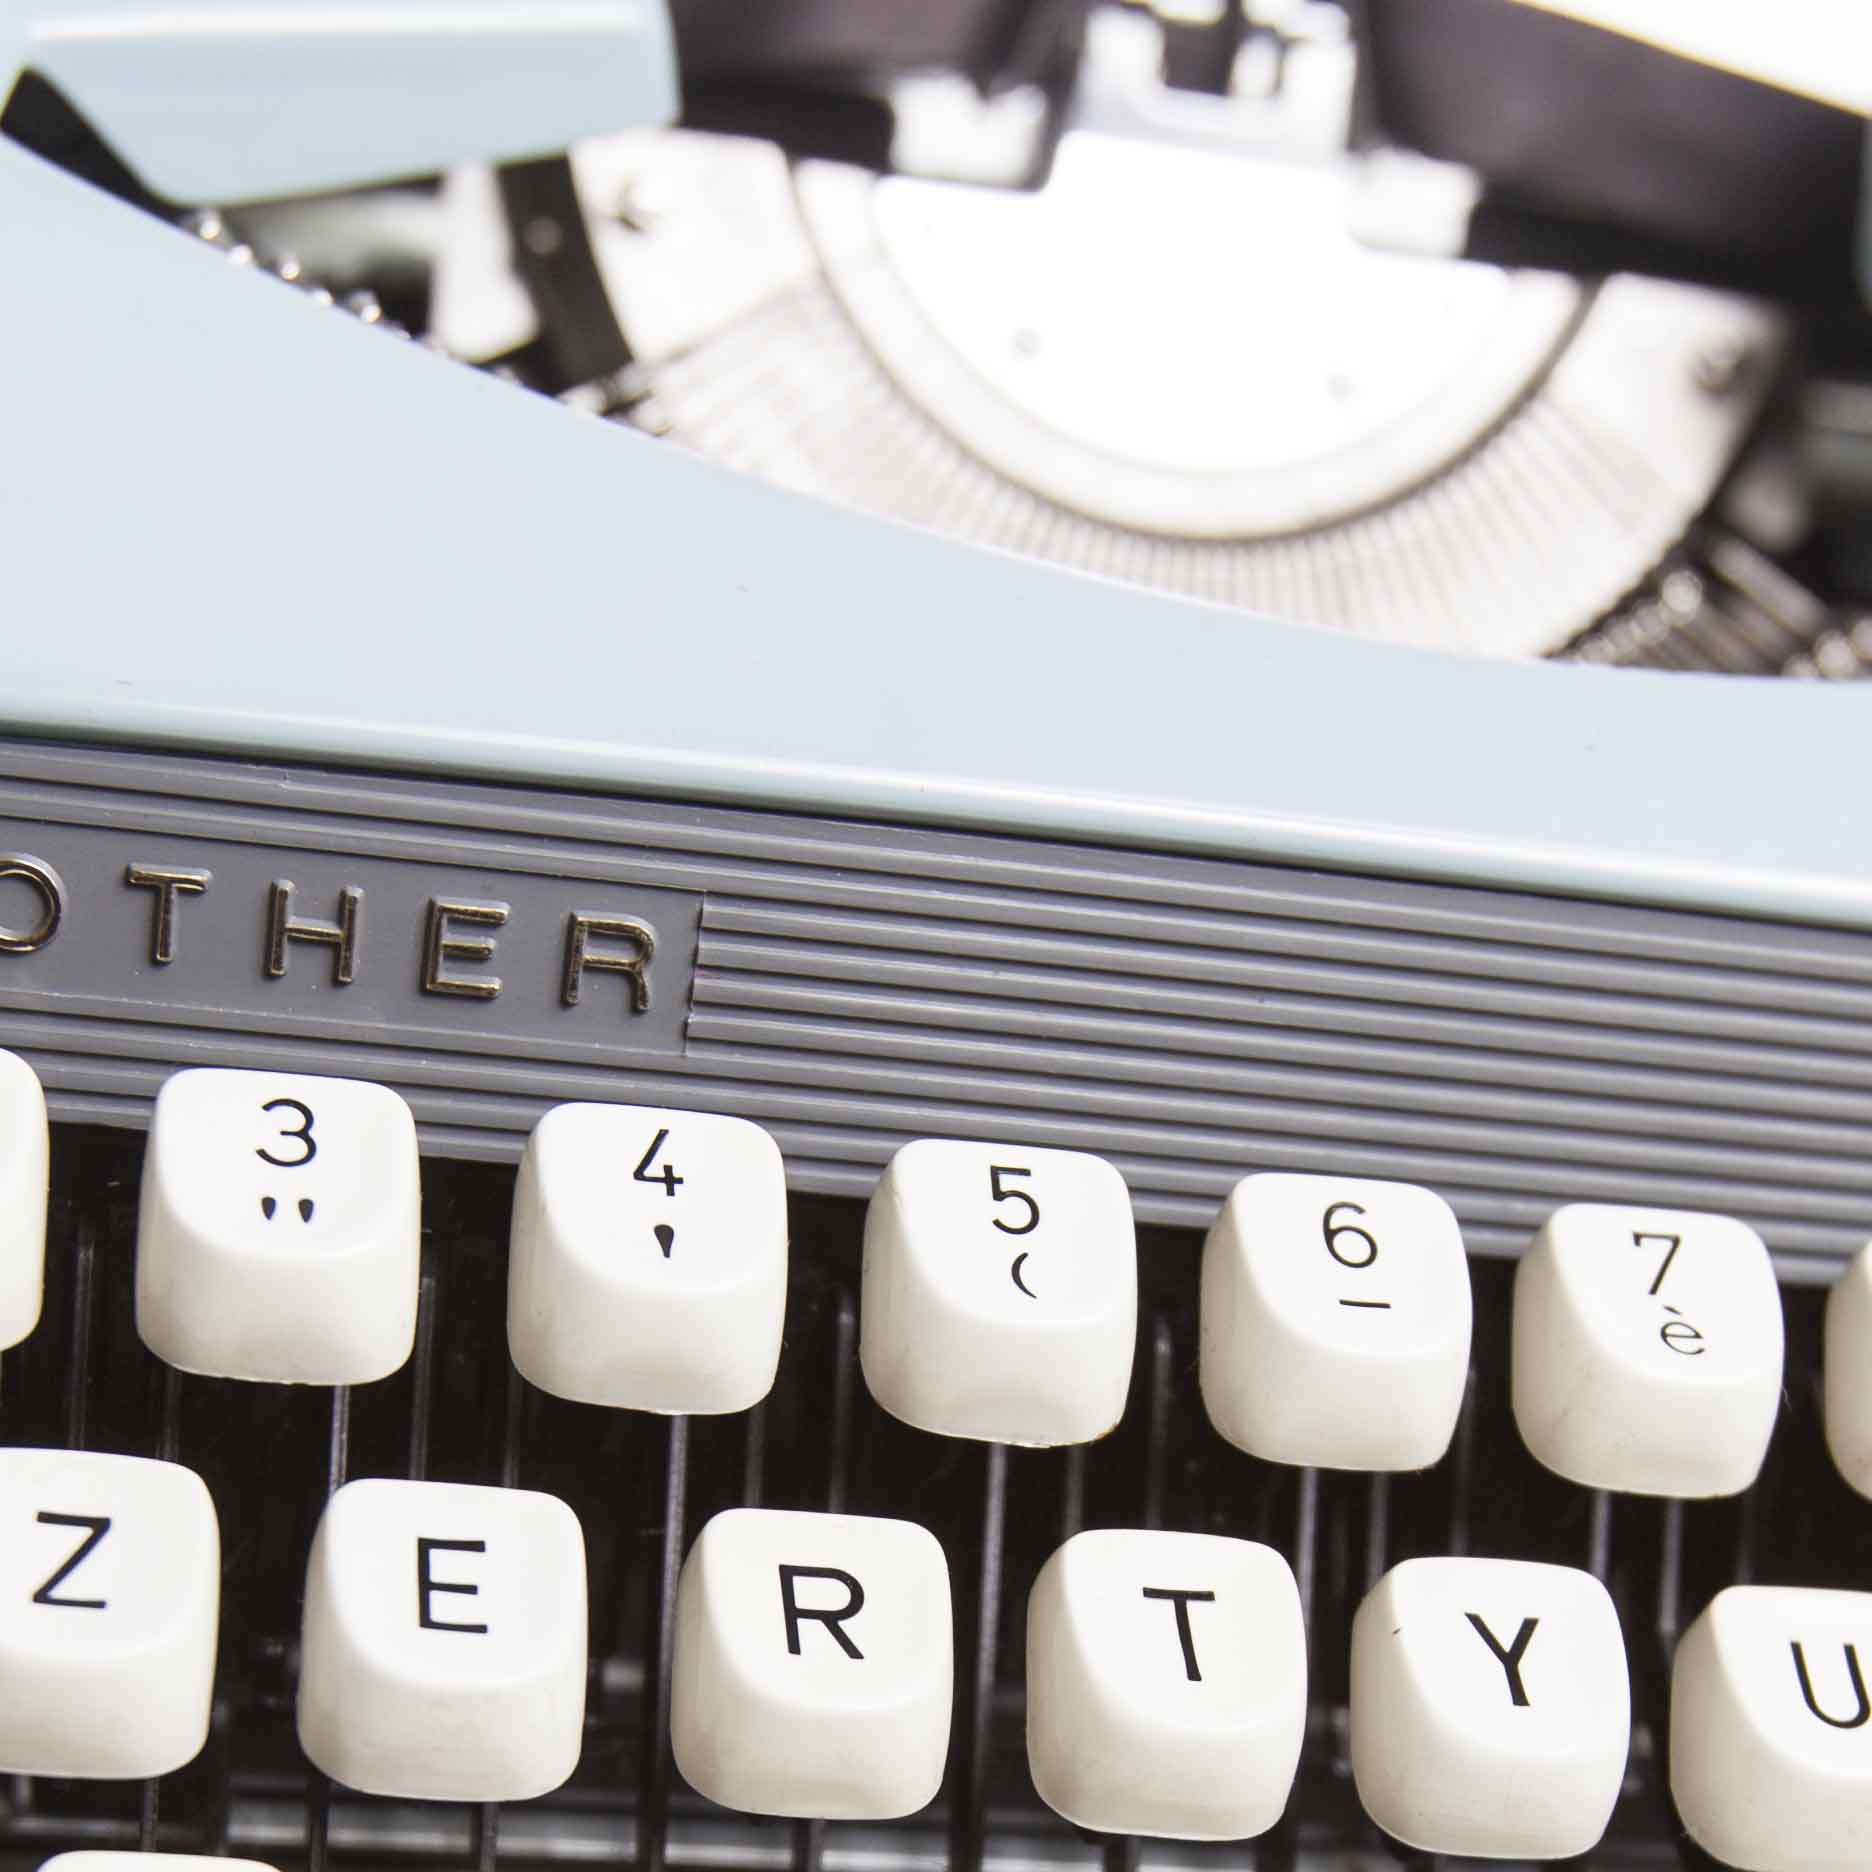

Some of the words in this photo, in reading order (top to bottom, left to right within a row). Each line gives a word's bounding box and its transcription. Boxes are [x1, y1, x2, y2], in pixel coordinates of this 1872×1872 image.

[256, 1098, 317, 1168] 3
[632, 1127, 685, 1198] 4
[990, 1165, 1040, 1235] 5
[1321, 1200, 1379, 1270] 6
[1631, 1230, 1682, 1297] 7
[1658, 1303, 1707, 1358] è
[32, 1511, 112, 1609] Z
[417, 1537, 488, 1634] E
[778, 1564, 865, 1660] R
[1142, 1587, 1215, 1682] T
[1465, 1612, 1539, 1707] Y
[1790, 1641, 1871, 1729] U
